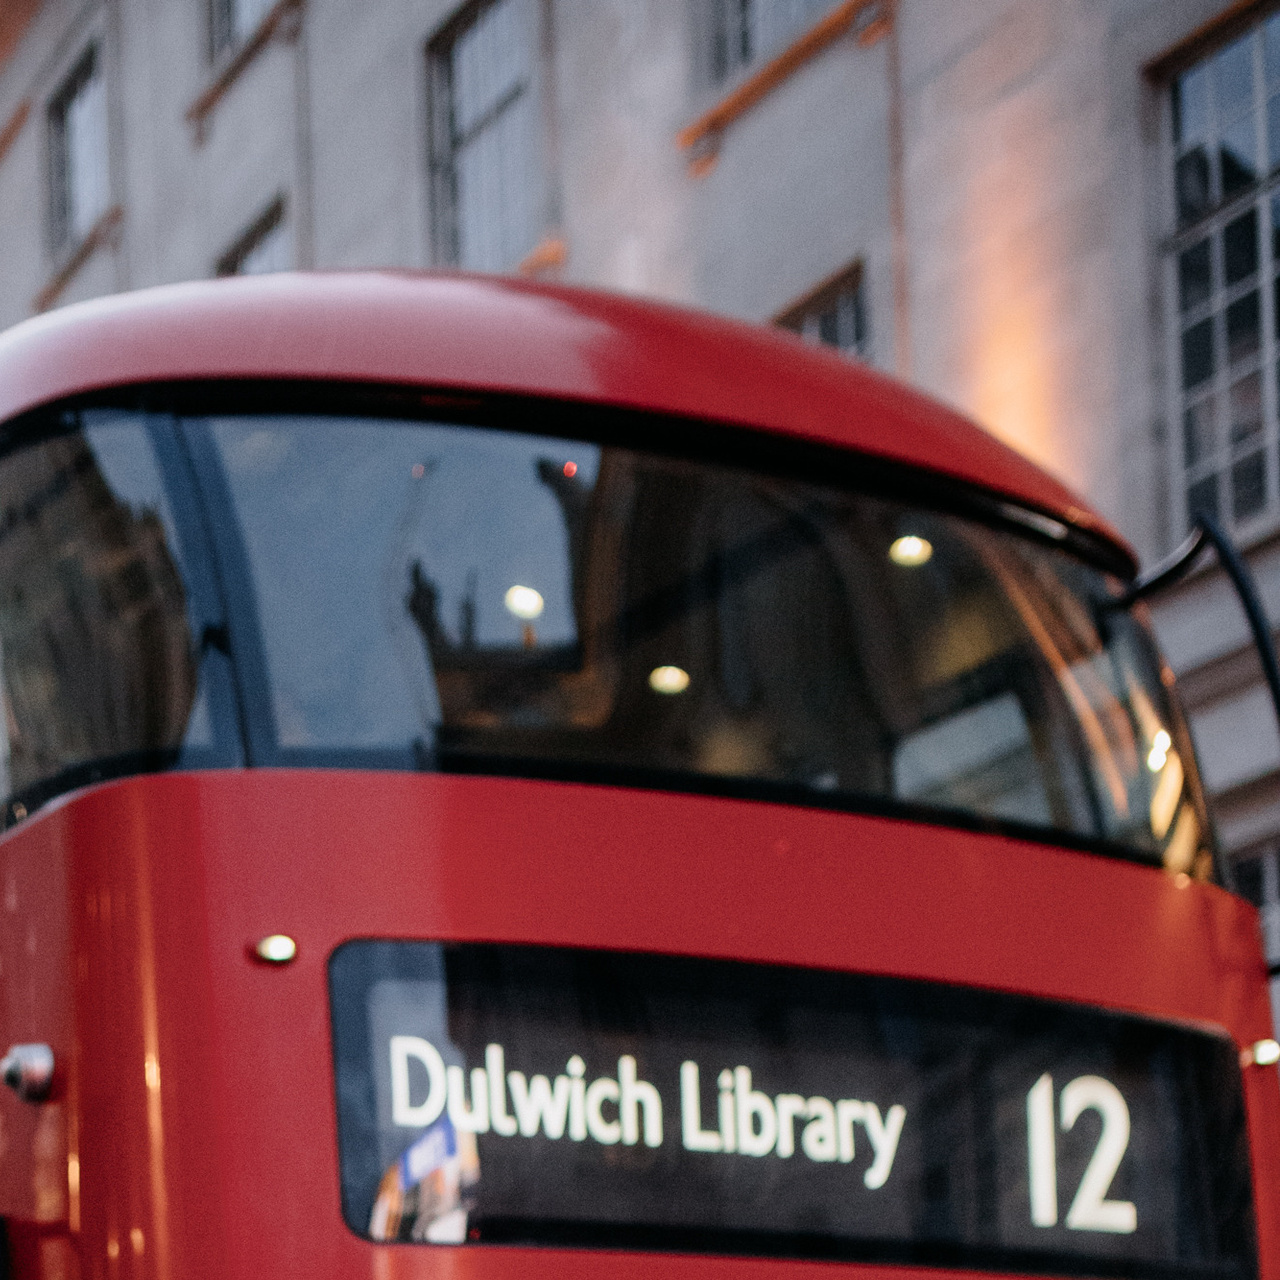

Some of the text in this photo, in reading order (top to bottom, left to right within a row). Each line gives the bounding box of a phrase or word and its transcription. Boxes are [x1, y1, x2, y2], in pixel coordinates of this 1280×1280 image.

[389, 1035, 906, 1190] Dulwich Library
[1026, 1071, 1138, 1234] 12
